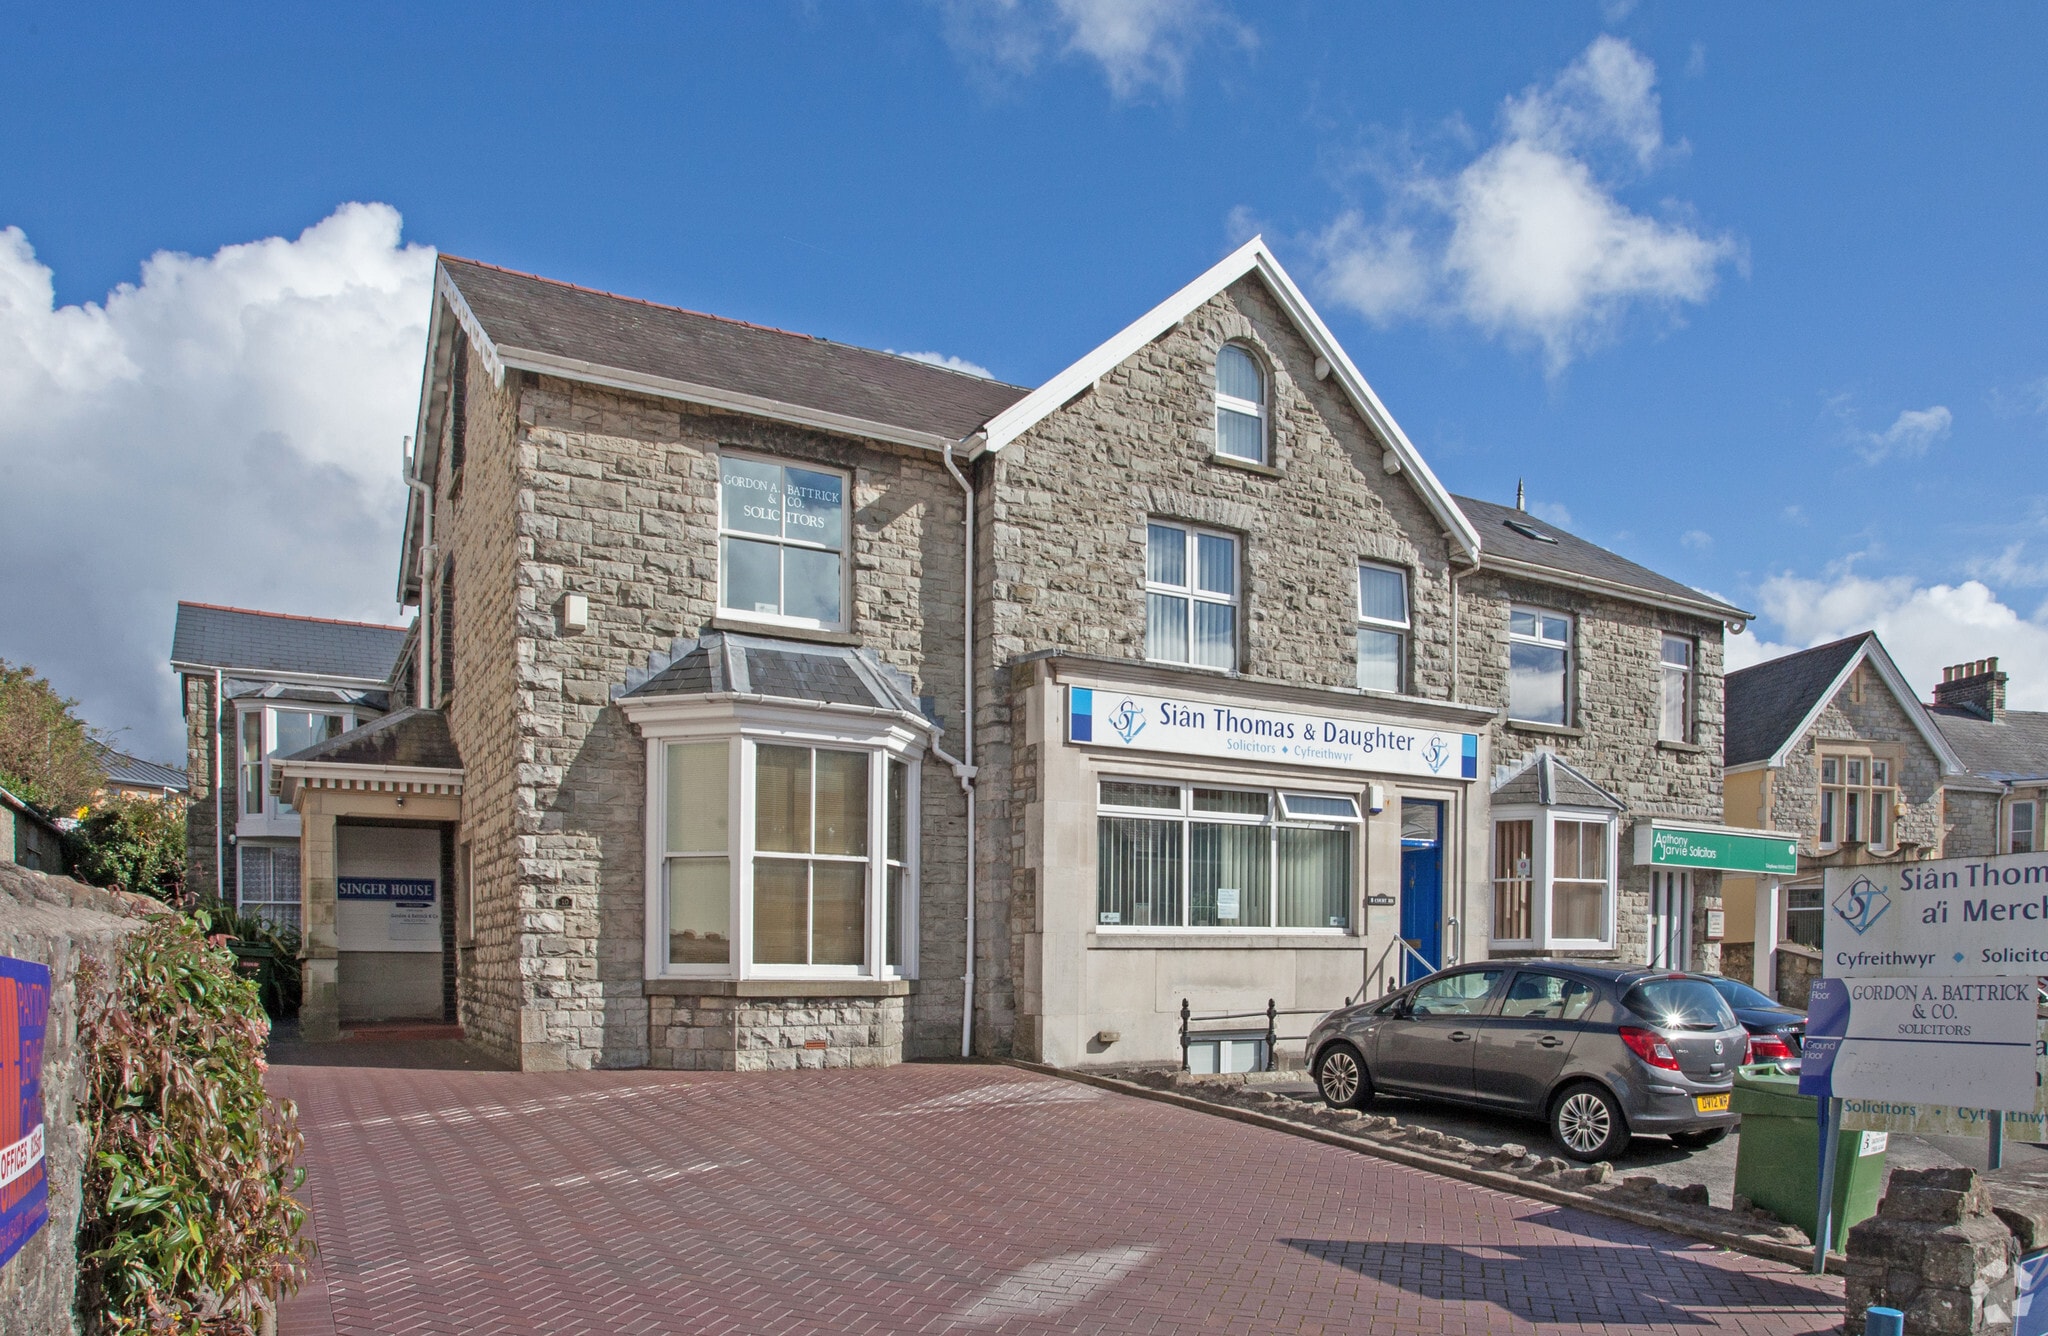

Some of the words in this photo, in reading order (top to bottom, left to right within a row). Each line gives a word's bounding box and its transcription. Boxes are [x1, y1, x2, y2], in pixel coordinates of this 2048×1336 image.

[724, 474, 768, 490] GORDON
[770, 483, 780, 493] A.
[787, 484, 840, 503] BATTRICK
[768, 495, 776, 504] &
[787, 497, 805, 509] CO.
[743, 505, 825, 528] SOLICITORS
[1160, 702, 1205, 729] Siân
[1213, 708, 1294, 738] Thomas
[1303, 723, 1316, 740] &
[1324, 721, 1415, 754] Daughter
[1227, 738, 1276, 753] Solicitors
[1294, 745, 1353, 762] Cyfreithwyr
[1660, 844, 1688, 860] Jarvie
[1689, 846, 1716, 859] Solicitors
[1900, 867, 1958, 891] Siân
[339, 883, 387, 895] SINGER
[391, 884, 432, 896] HOUSE
[1836, 951, 1936, 969] Cyfreithwyr
[1812, 981, 1826, 990] First
[1852, 984, 1917, 1001] GORDON
[1922, 985, 1937, 1001] A.
[1942, 984, 2029, 1001] BATTRICK
[1812, 991, 1829, 1000] Floor
[1912, 1004, 1926, 1019] &
[1932, 1004, 1958, 1020] CO.
[1898, 1024, 1971, 1036] SOLICITORS
[1805, 1041, 1836, 1051] Ground
[1804, 1051, 1824, 1060] Floor
[1845, 1100, 1916, 1116] Solicitors
[1, 1141, 27, 1180] OFFICES
